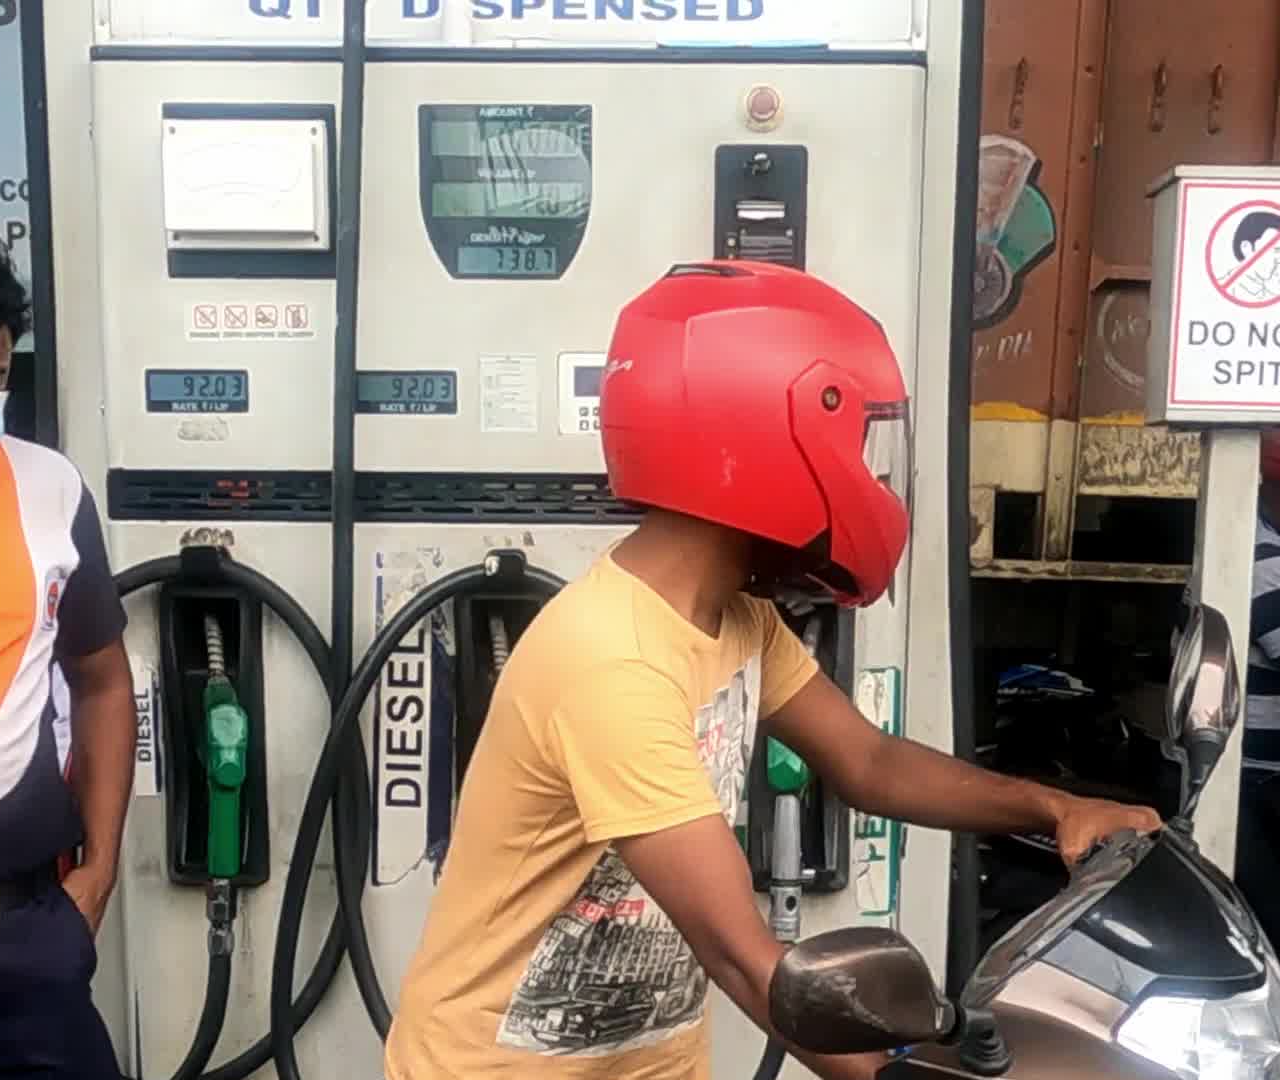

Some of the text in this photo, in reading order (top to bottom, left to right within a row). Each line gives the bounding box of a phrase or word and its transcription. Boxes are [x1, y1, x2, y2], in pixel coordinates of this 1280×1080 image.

[1188, 320, 1236, 347] DO
[183, 376, 243, 397] 92.03
[391, 377, 451, 399] 92.03
[136, 688, 152, 762] DIESEL
[385, 628, 425, 808] DIESEL
